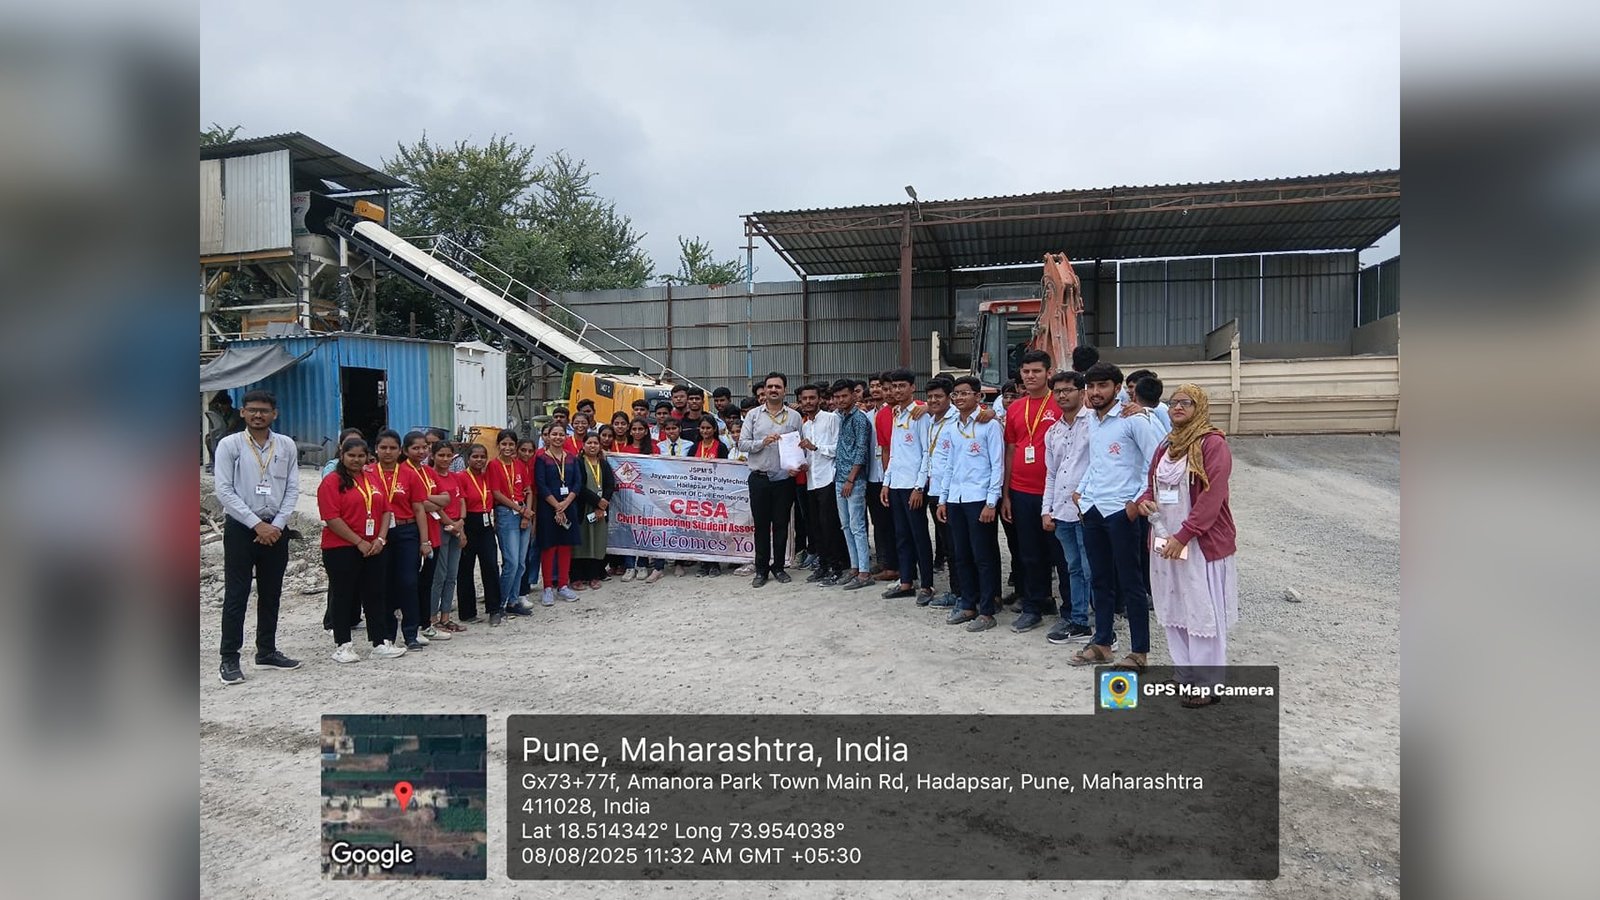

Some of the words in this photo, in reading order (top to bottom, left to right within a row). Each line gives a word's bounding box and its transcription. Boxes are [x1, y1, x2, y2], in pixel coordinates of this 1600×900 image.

[649, 488, 687, 496] Department
[712, 493, 749, 503] Engineering
[669, 498, 729, 519] CESA
[617, 512, 636, 524] Civil
[637, 515, 691, 529] Engineering
[692, 519, 727, 532] Student
[728, 522, 756, 533] Assoc
[632, 529, 727, 551] Welcomes
[733, 536, 754, 553] Yo
